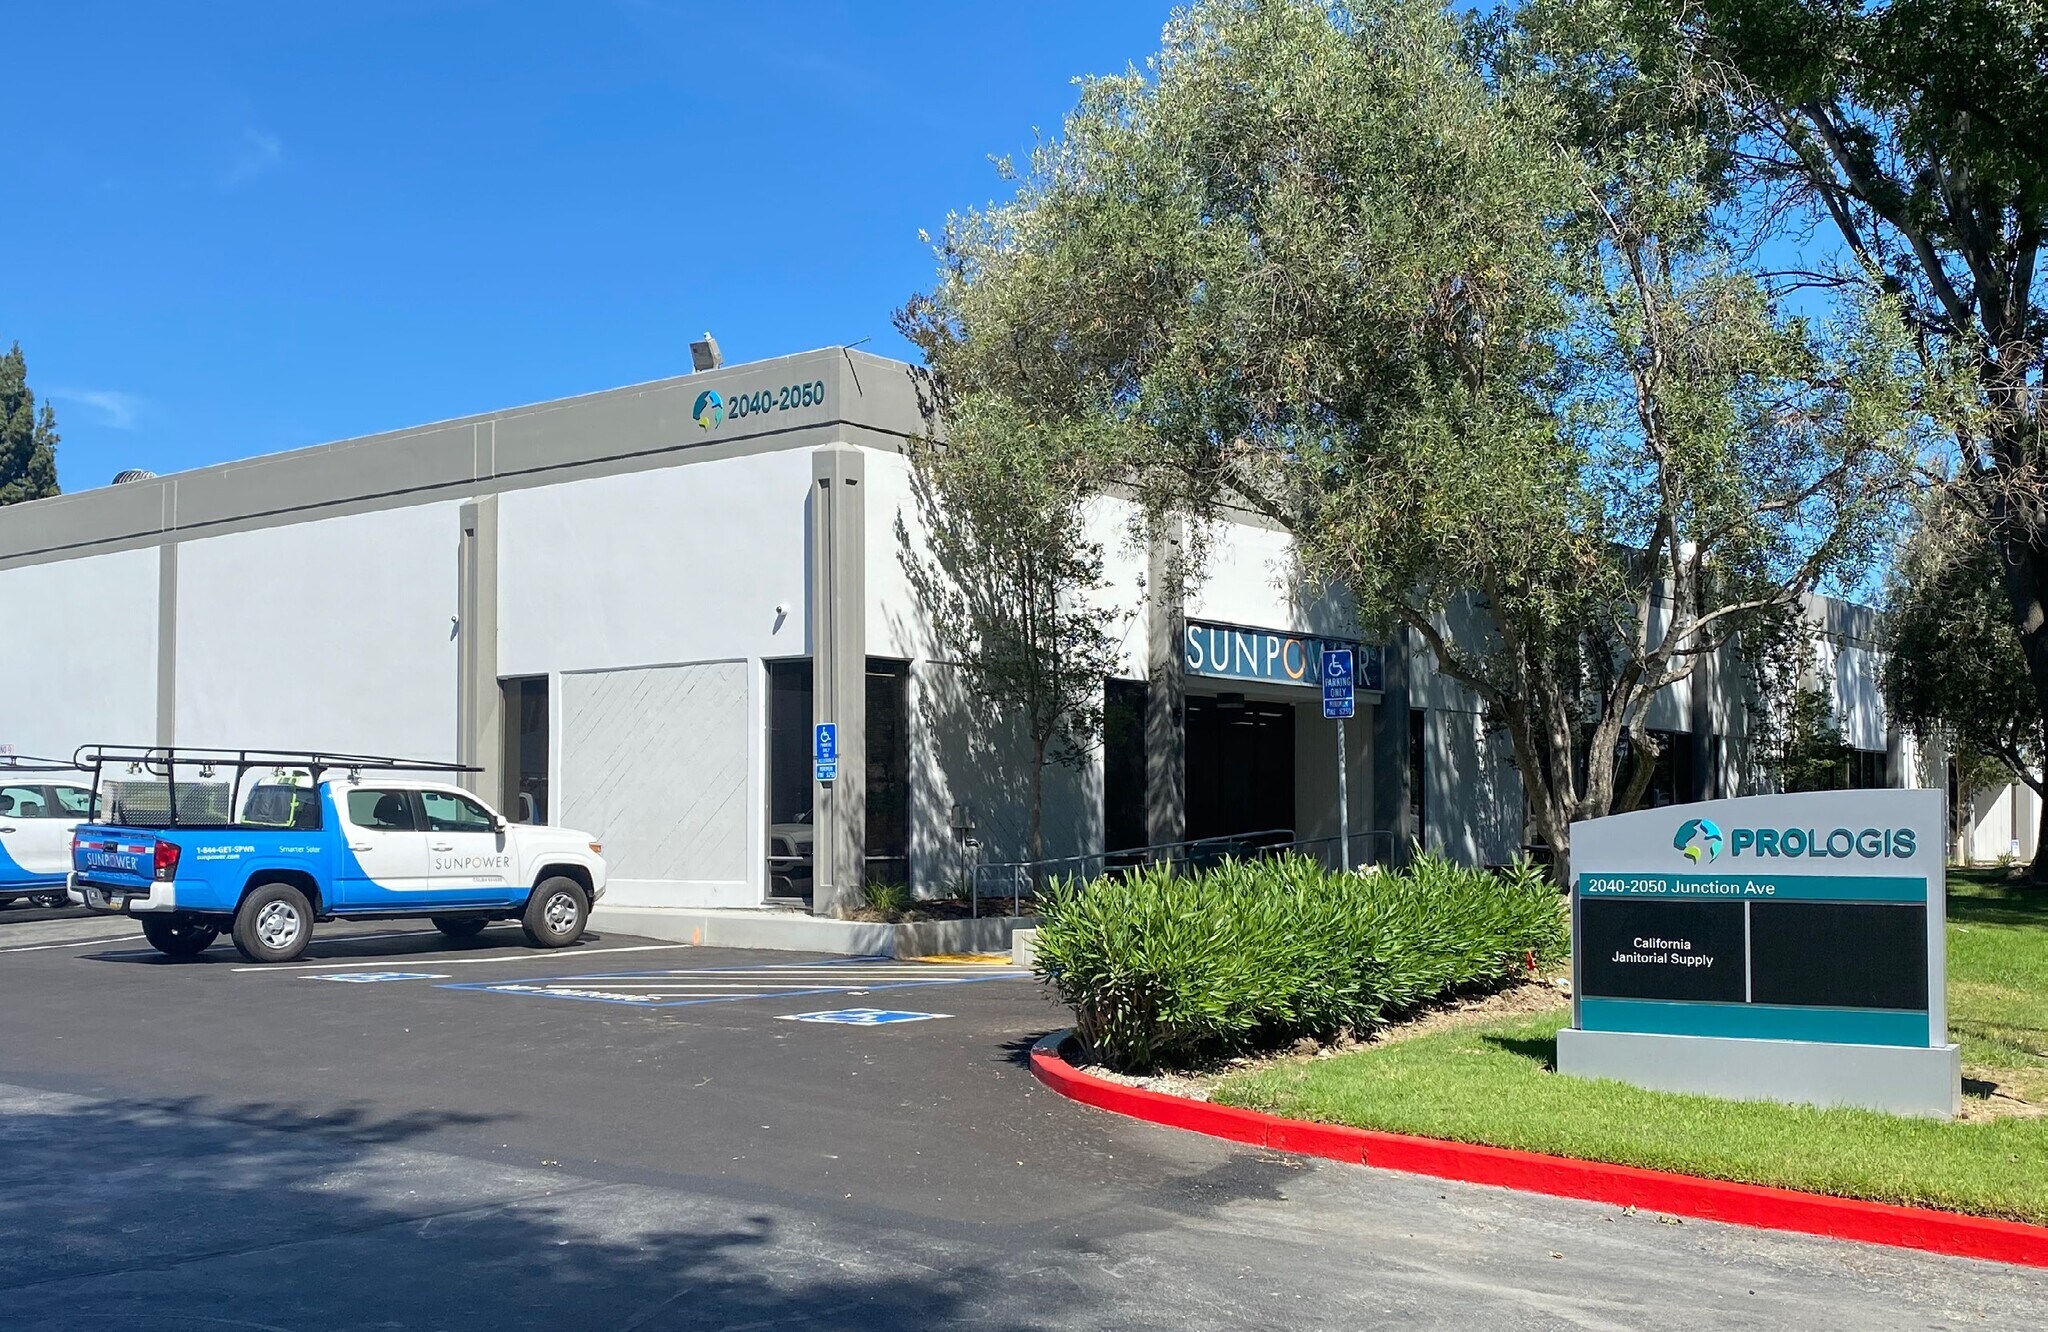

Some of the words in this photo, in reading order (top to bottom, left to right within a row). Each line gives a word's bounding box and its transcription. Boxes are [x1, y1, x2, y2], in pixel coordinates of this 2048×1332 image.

[728, 380, 825, 419] 2040-2050
[1325, 677, 1351, 687] PARKING
[1330, 688, 1347, 698] ONLY
[196, 846, 255, 854] 1-844-GET-SPWR
[1732, 828, 1917, 858] PROLOGIS
[87, 853, 137, 870] SUNPOWER
[435, 856, 509, 870] SUNPOWER
[1588, 879, 1666, 893] 2040-2050
[1671, 881, 1739, 895] Junction
[1744, 881, 1776, 895] Ave
[1633, 937, 1691, 950] California
[1612, 951, 1667, 964] Janitorial
[1671, 953, 1714, 967] Supply
